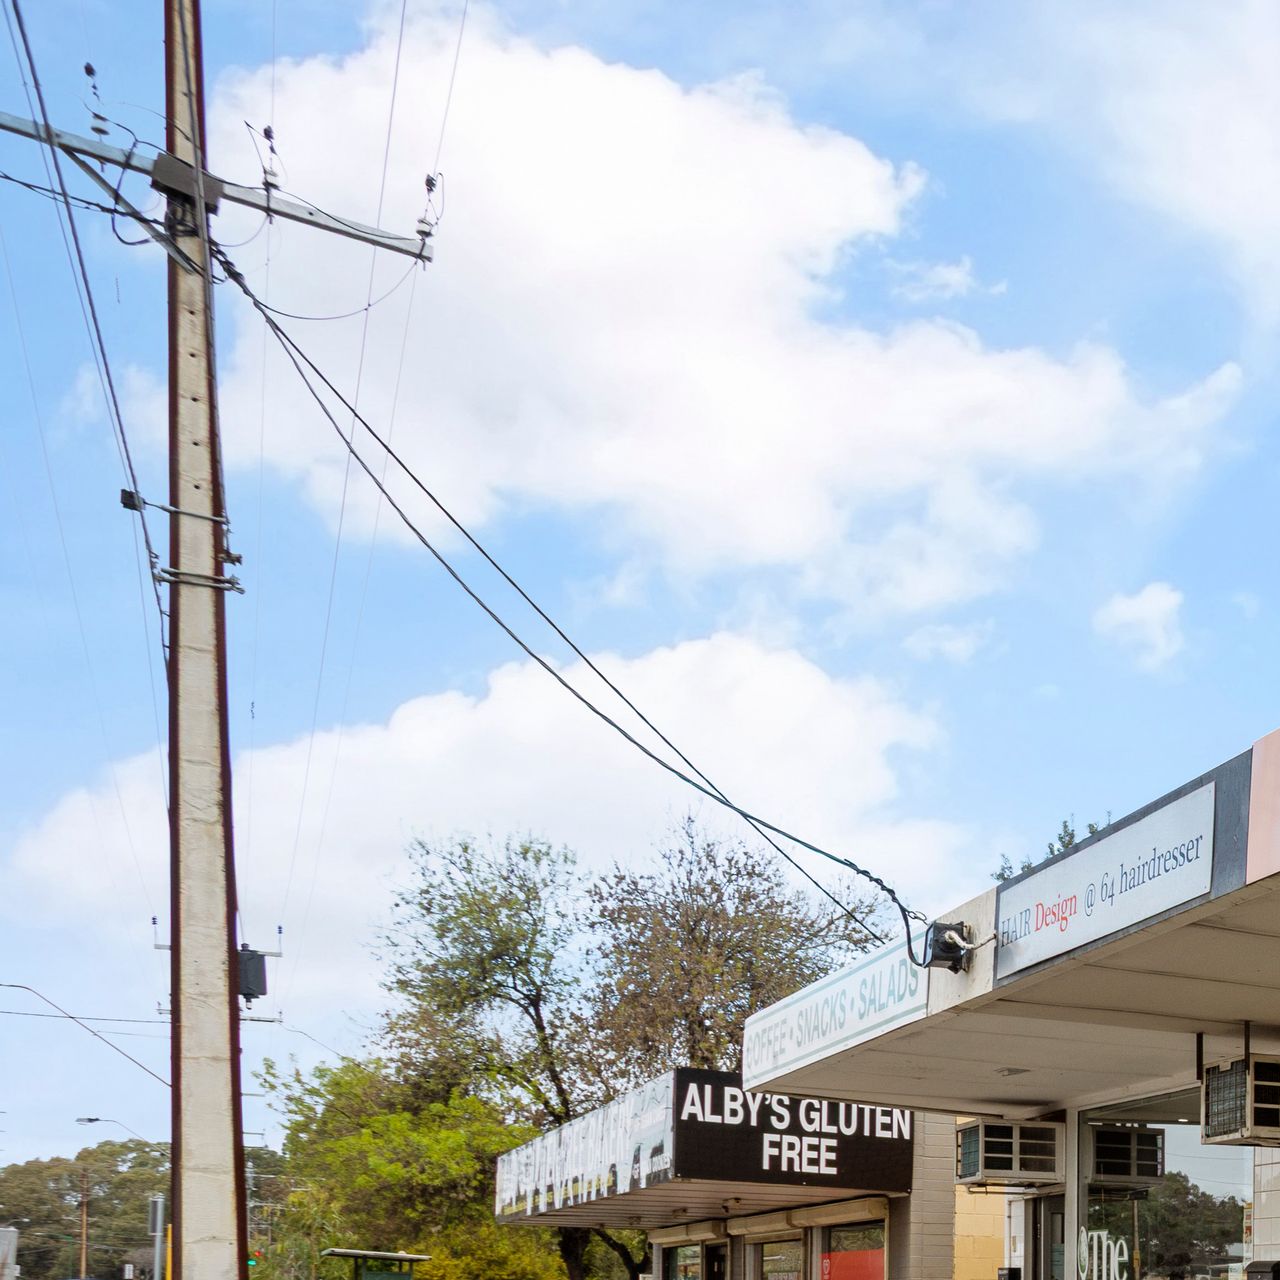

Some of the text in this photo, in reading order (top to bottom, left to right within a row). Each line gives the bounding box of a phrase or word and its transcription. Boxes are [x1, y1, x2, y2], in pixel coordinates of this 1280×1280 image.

[1001, 834, 1203, 948] HAIR Design @ 64 hairdresser
[746, 951, 920, 1070] COFFEE SNACKS SALADS
[680, 1082, 911, 1140] ALBY'S GLUTEN
[762, 1133, 838, 1175] FREE
